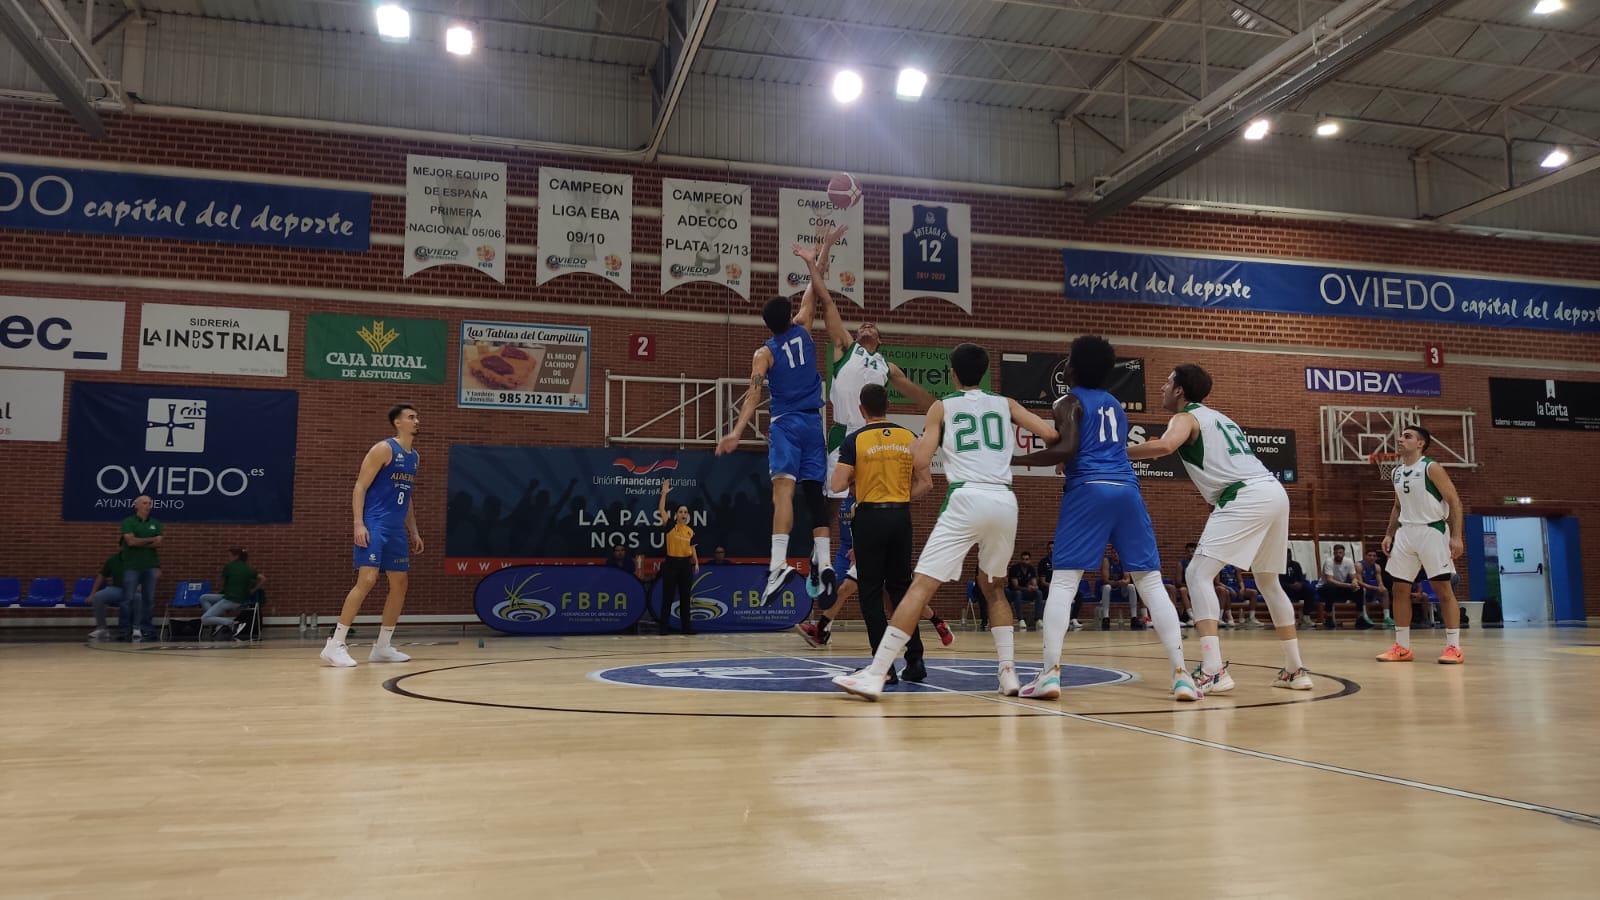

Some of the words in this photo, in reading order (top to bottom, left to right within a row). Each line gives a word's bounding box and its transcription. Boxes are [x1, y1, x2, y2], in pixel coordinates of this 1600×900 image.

[413, 166, 453, 179] MEJOR
[455, 170, 500, 183] EQUIPO
[424, 186, 440, 197] DE
[443, 186, 488, 200] ESPAÑA
[549, 178, 623, 196] CAMPEON
[672, 189, 743, 205] CAMPEON
[84, 196, 186, 228] capital
[195, 201, 241, 231] del
[250, 205, 354, 239] deporte
[430, 206, 482, 218] PRIMERA
[551, 204, 587, 218] LIGA
[591, 207, 620, 221] EBA
[409, 223, 469, 237] NACIONAL
[472, 228, 501, 239] 05/06
[677, 215, 738, 230] ADECCO
[808, 218, 837, 228] COPA
[566, 231, 605, 245] 09/10
[665, 238, 710, 253] PLATA
[714, 243, 749, 257] 12/13
[920, 239, 942, 263] 12
[1070, 270, 1139, 295] capital
[1145, 271, 1176, 297] del
[1182, 274, 1252, 301] deporte
[1319, 273, 1455, 313] OVIEDO
[1461, 297, 1519, 320] capital
[1523, 299, 1550, 320] del
[190, 317, 240, 329] SIDRERÍA
[466, 326, 483, 339] Las
[485, 328, 519, 340] Tablas
[521, 330, 536, 341] del
[637, 336, 649, 356] 2
[782, 336, 805, 369] 17
[326, 351, 368, 367] CAJA
[371, 354, 428, 371] RURAL
[864, 357, 878, 370] 14
[1430, 347, 1440, 364] 3
[342, 369, 357, 378] DE
[359, 370, 412, 380] ASTURIAS
[539, 378, 570, 386] ASTURIAS
[499, 393, 521, 404] 985
[524, 394, 543, 405] 212
[545, 395, 563, 406] 411
[1536, 401, 1545, 416] la
[1545, 402, 1569, 417] Carta
[953, 412, 1004, 452] 20
[1098, 406, 1119, 443] 11
[1257, 446, 1279, 454] OVIEDO
[1403, 480, 1410, 494] 5
[397, 492, 405, 505] 8
[579, 508, 610, 527] LA
[591, 532, 640, 549] NOS
[561, 591, 628, 609] FBPA
[733, 590, 796, 608] FBA
